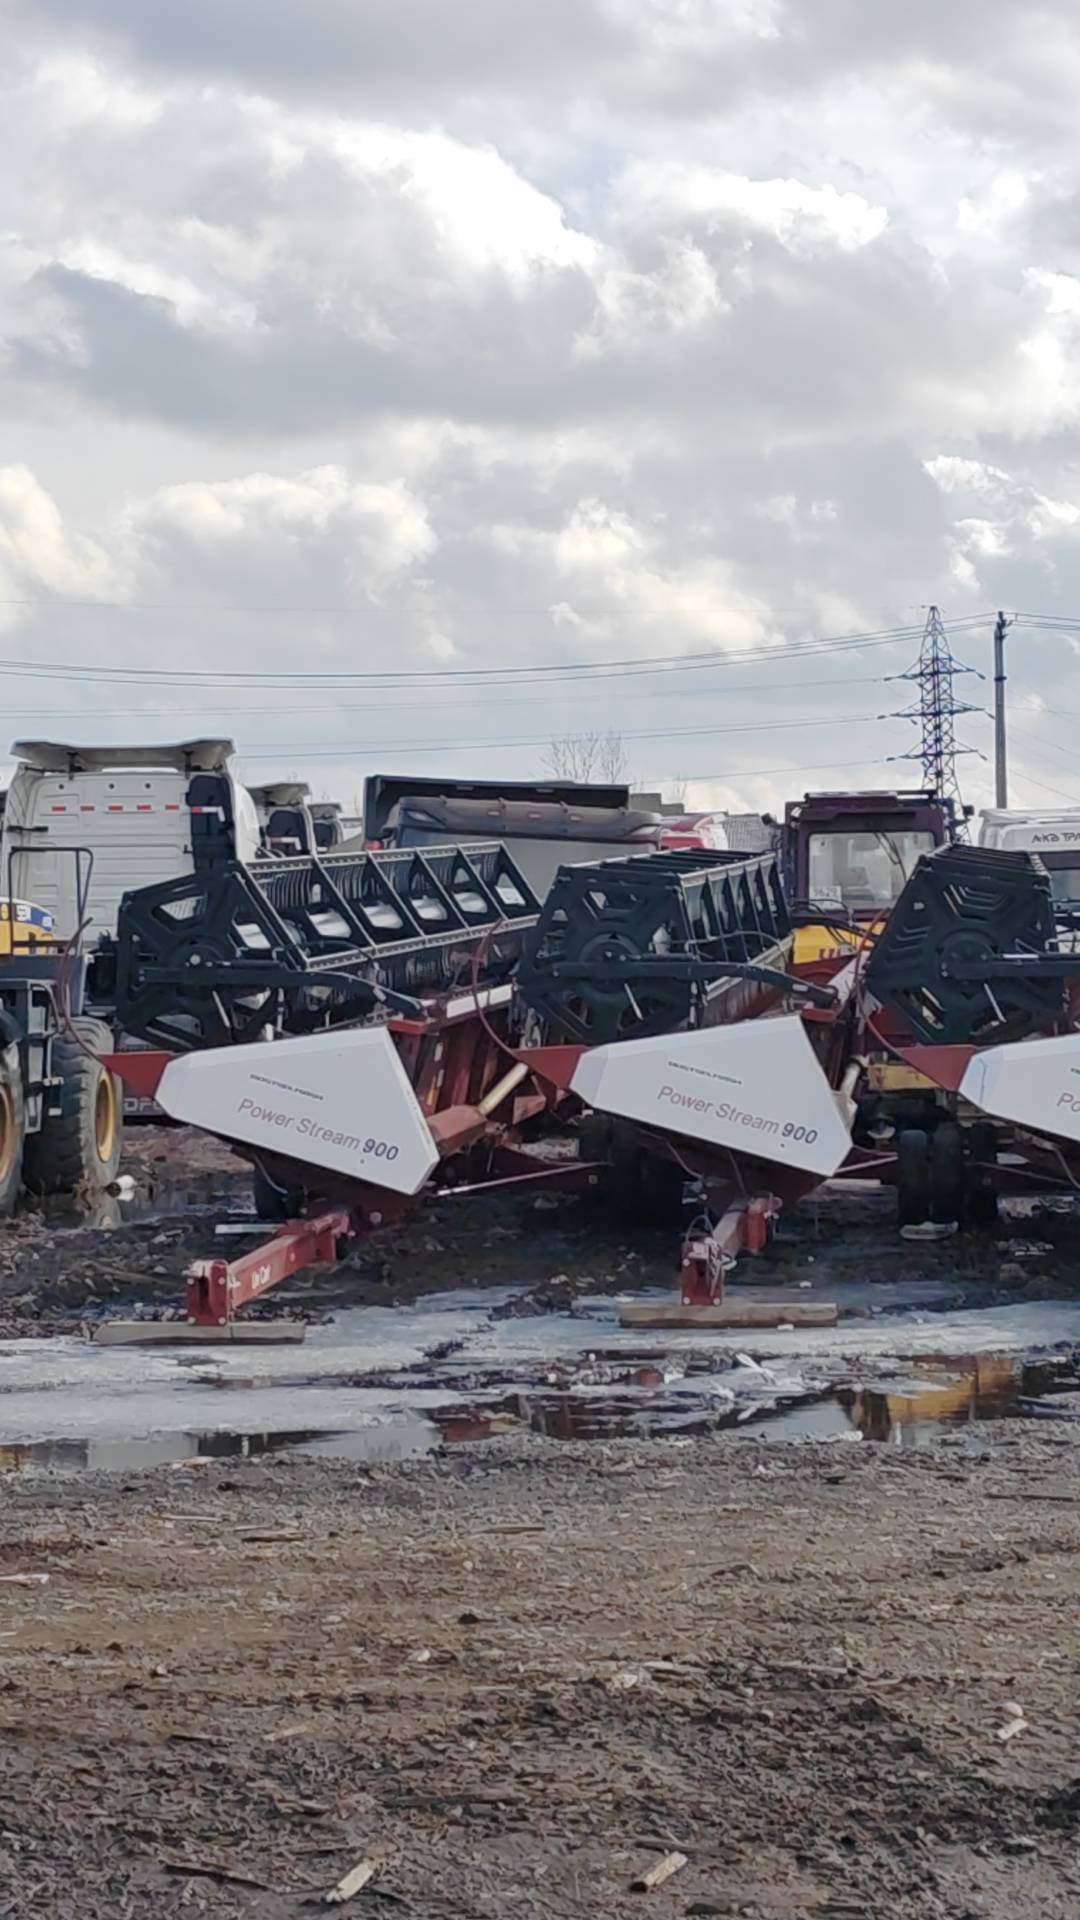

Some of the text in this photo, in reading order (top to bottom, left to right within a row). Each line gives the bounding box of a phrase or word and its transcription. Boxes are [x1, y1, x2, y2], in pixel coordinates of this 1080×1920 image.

[238, 1098, 399, 1161] Power Stream 900
[657, 1085, 818, 1144] Power Stream 900
